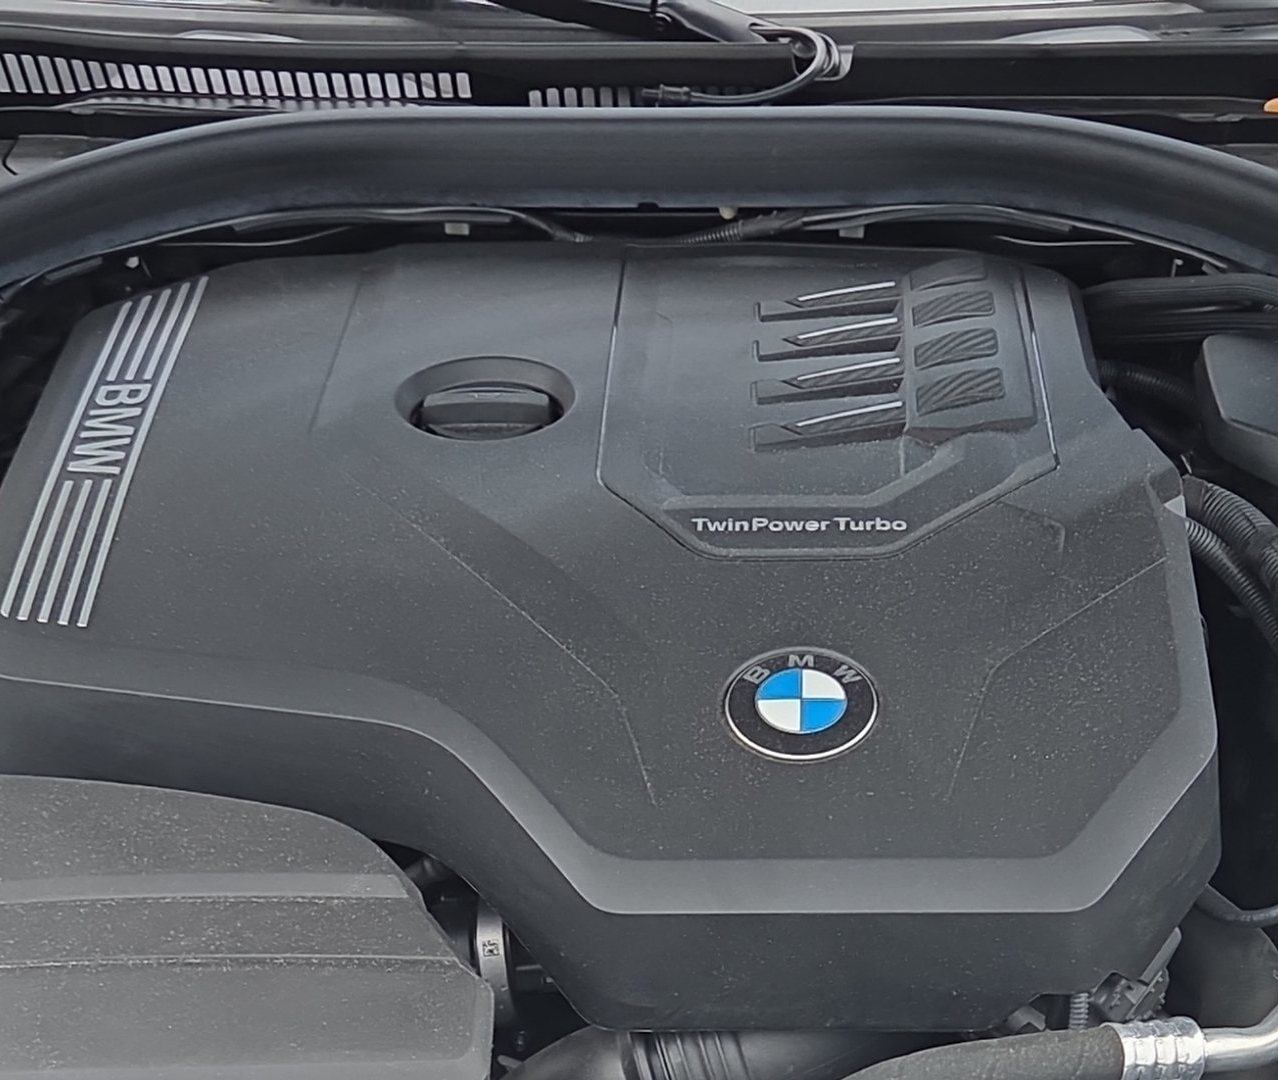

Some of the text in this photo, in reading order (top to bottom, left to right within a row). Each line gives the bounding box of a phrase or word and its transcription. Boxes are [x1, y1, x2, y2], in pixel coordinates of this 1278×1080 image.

[66, 383, 152, 475] BMW
[691, 517, 908, 532] TwinPower Turbo
[742, 654, 863, 685] BMW
